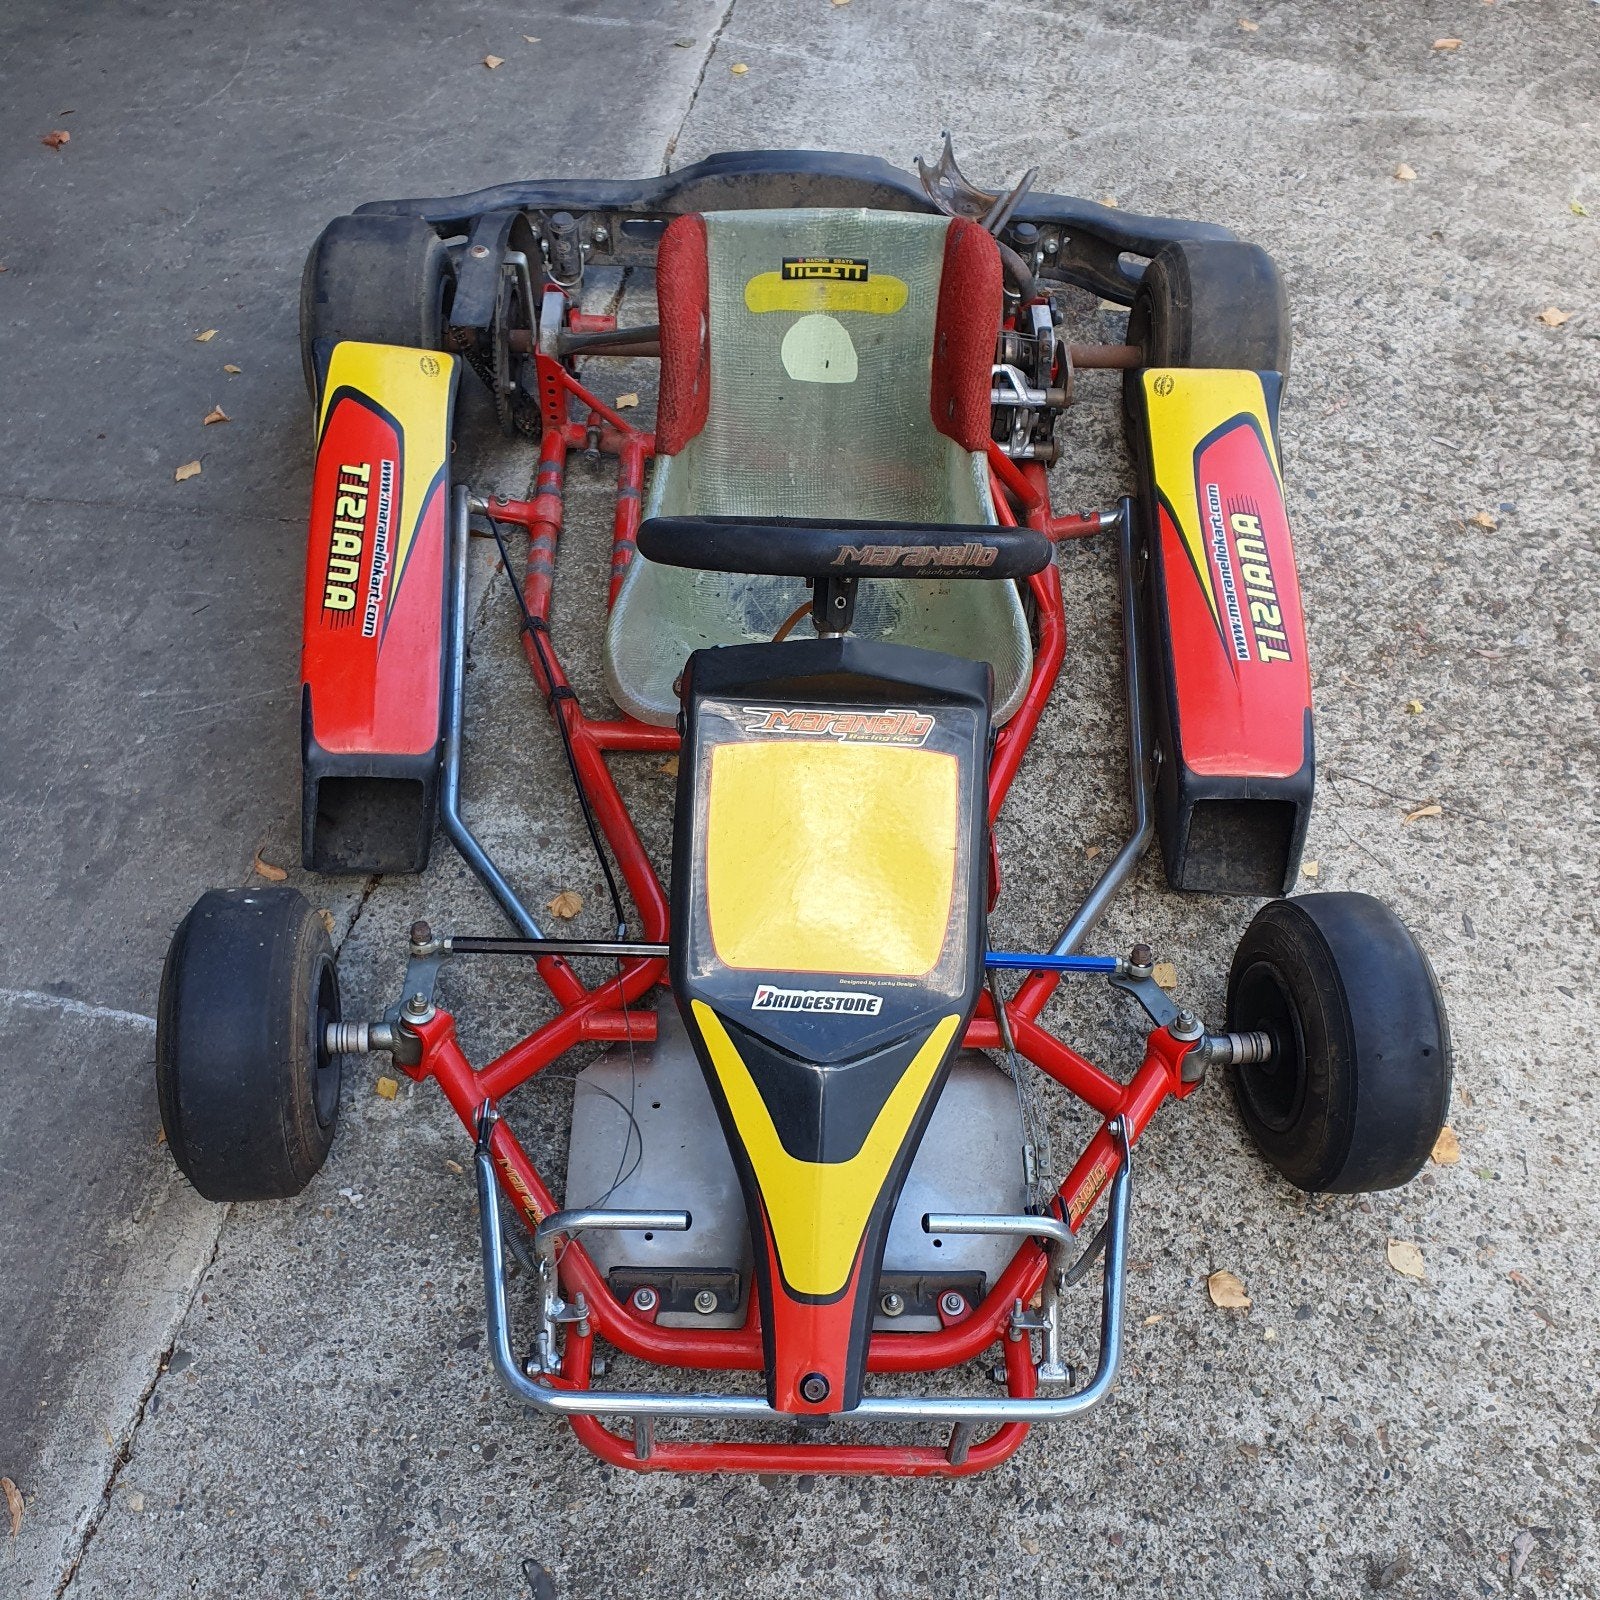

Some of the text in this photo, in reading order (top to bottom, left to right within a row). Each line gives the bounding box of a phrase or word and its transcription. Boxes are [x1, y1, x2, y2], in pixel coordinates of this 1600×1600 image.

[785, 263, 867, 279] TILLETT
[323, 463, 371, 611] TIZIANA
[363, 461, 392, 636] www.maranellokart.com
[1208, 484, 1248, 660] www.maranellokart.com
[1230, 512, 1291, 662] TIZIANA
[848, 733, 920, 743] Racing Kart
[756, 990, 878, 1013] BRIDGESTONE
[839, 978, 868, 986] Designed
[877, 980, 896, 988] Lucky
[896, 981, 918, 989] Design
